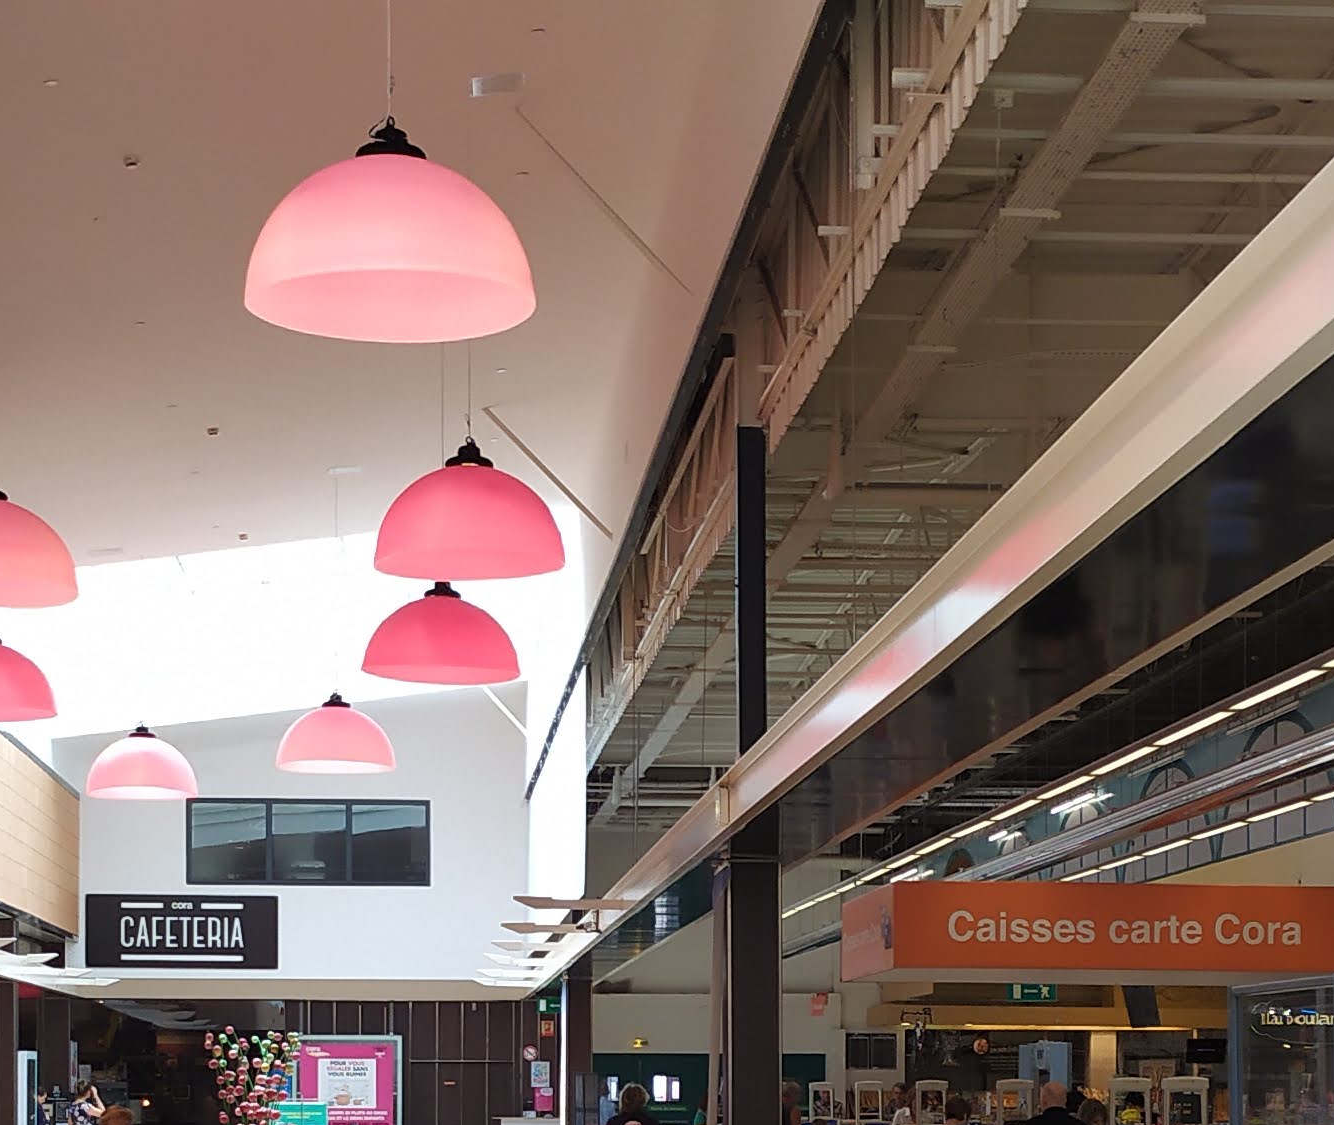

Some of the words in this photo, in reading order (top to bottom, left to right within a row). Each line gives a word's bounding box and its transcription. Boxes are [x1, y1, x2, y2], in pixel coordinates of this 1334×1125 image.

[171, 901, 194, 910] cora
[120, 915, 245, 949] CAFETERIA
[947, 910, 1097, 944] Caisses
[1108, 914, 1204, 945] carte
[1214, 913, 1303, 946] Cora
